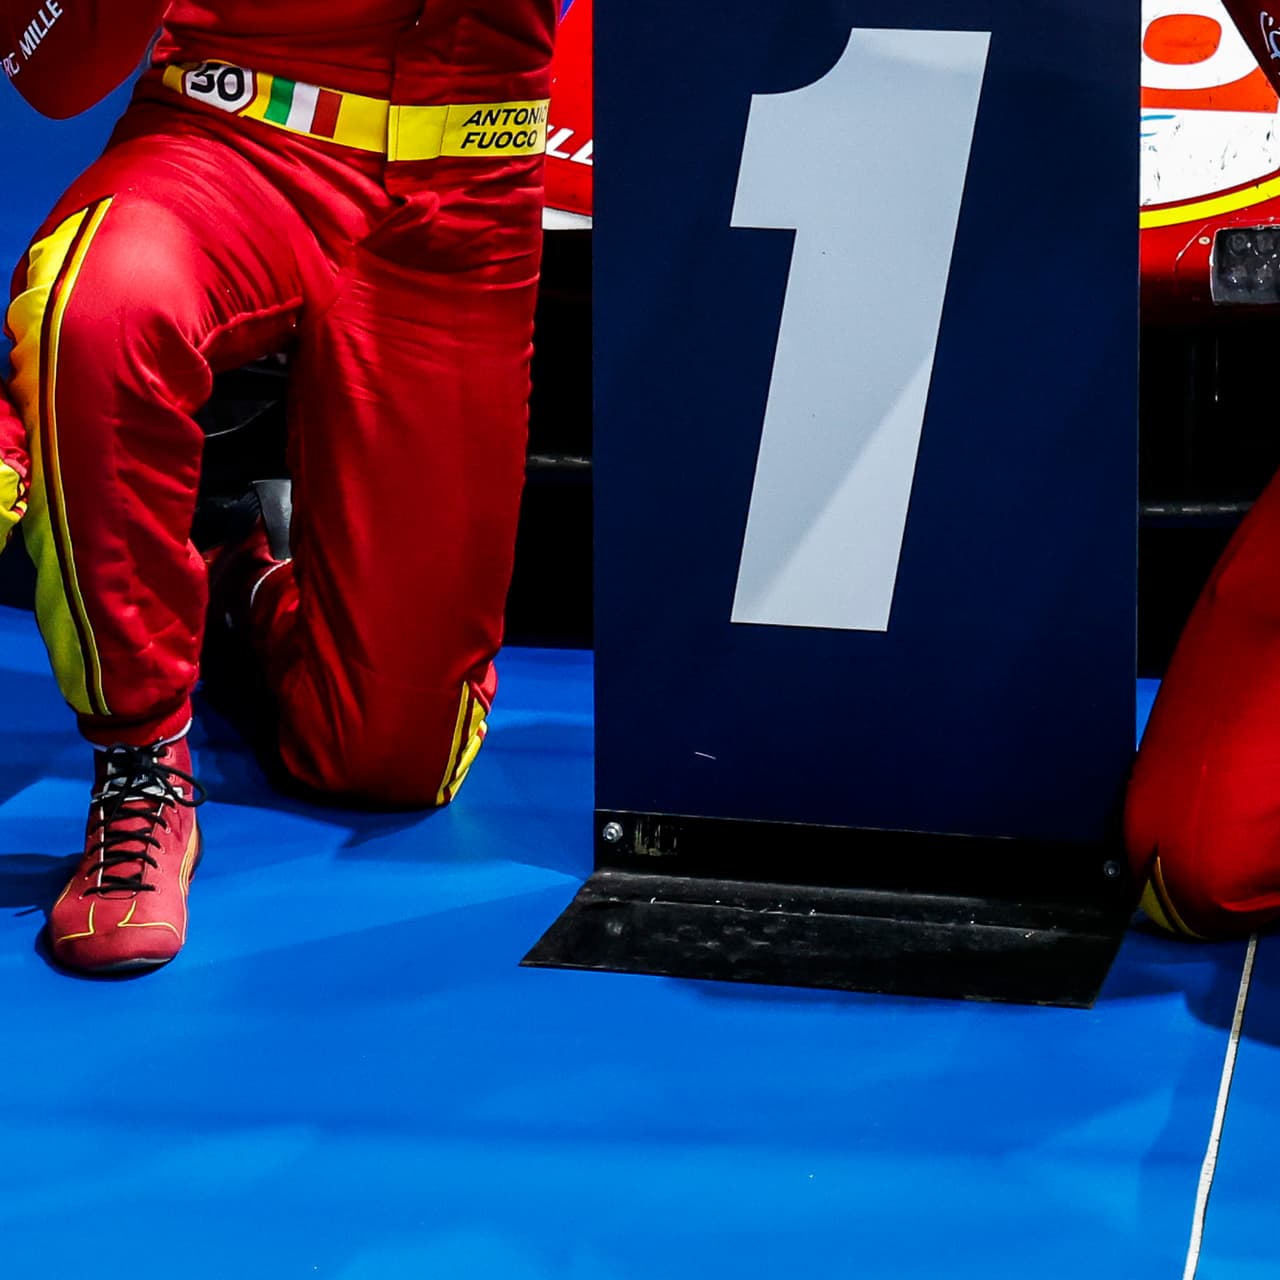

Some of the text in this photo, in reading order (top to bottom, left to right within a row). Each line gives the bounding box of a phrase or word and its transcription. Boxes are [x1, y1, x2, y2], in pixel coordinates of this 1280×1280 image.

[190, 63, 245, 102] 50
[460, 129, 538, 149] FUOCO
[730, 27, 992, 632] 1
